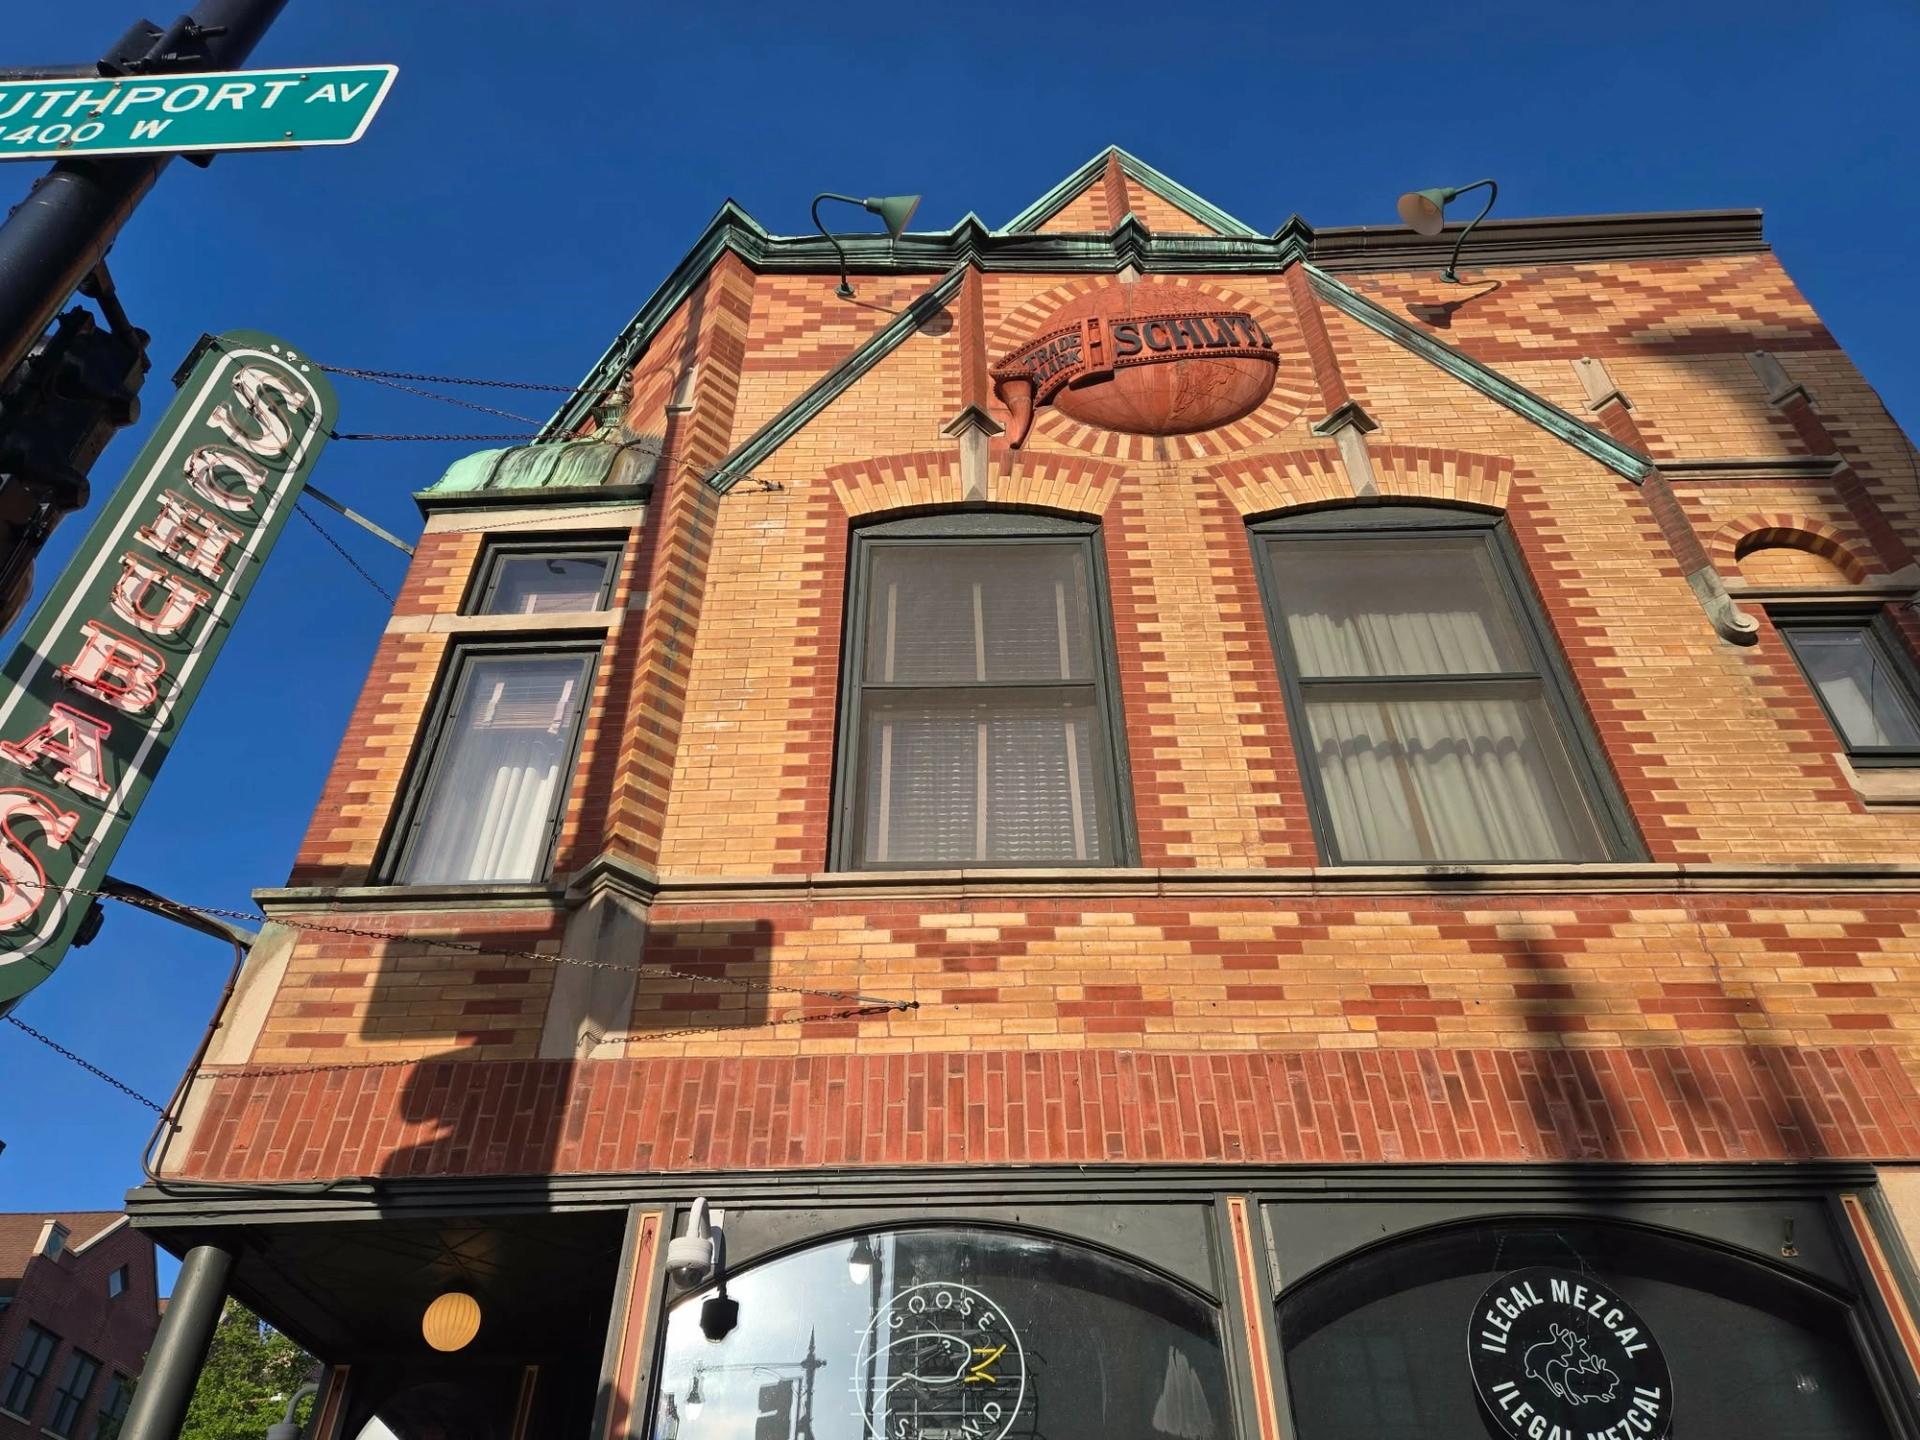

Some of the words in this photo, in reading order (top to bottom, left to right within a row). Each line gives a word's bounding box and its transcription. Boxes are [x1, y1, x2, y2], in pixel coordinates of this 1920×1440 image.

[304, 82, 370, 104] AV
[129, 119, 174, 140] W
[1022, 332, 1082, 372] TRADE
[1032, 346, 1084, 389] MARK
[0, 362, 309, 932] SCHUBAS
[887, 1291, 996, 1332] GOOSE
[1481, 1281, 1545, 1354] ILEGAL
[1550, 1278, 1649, 1360] MEZCAL
